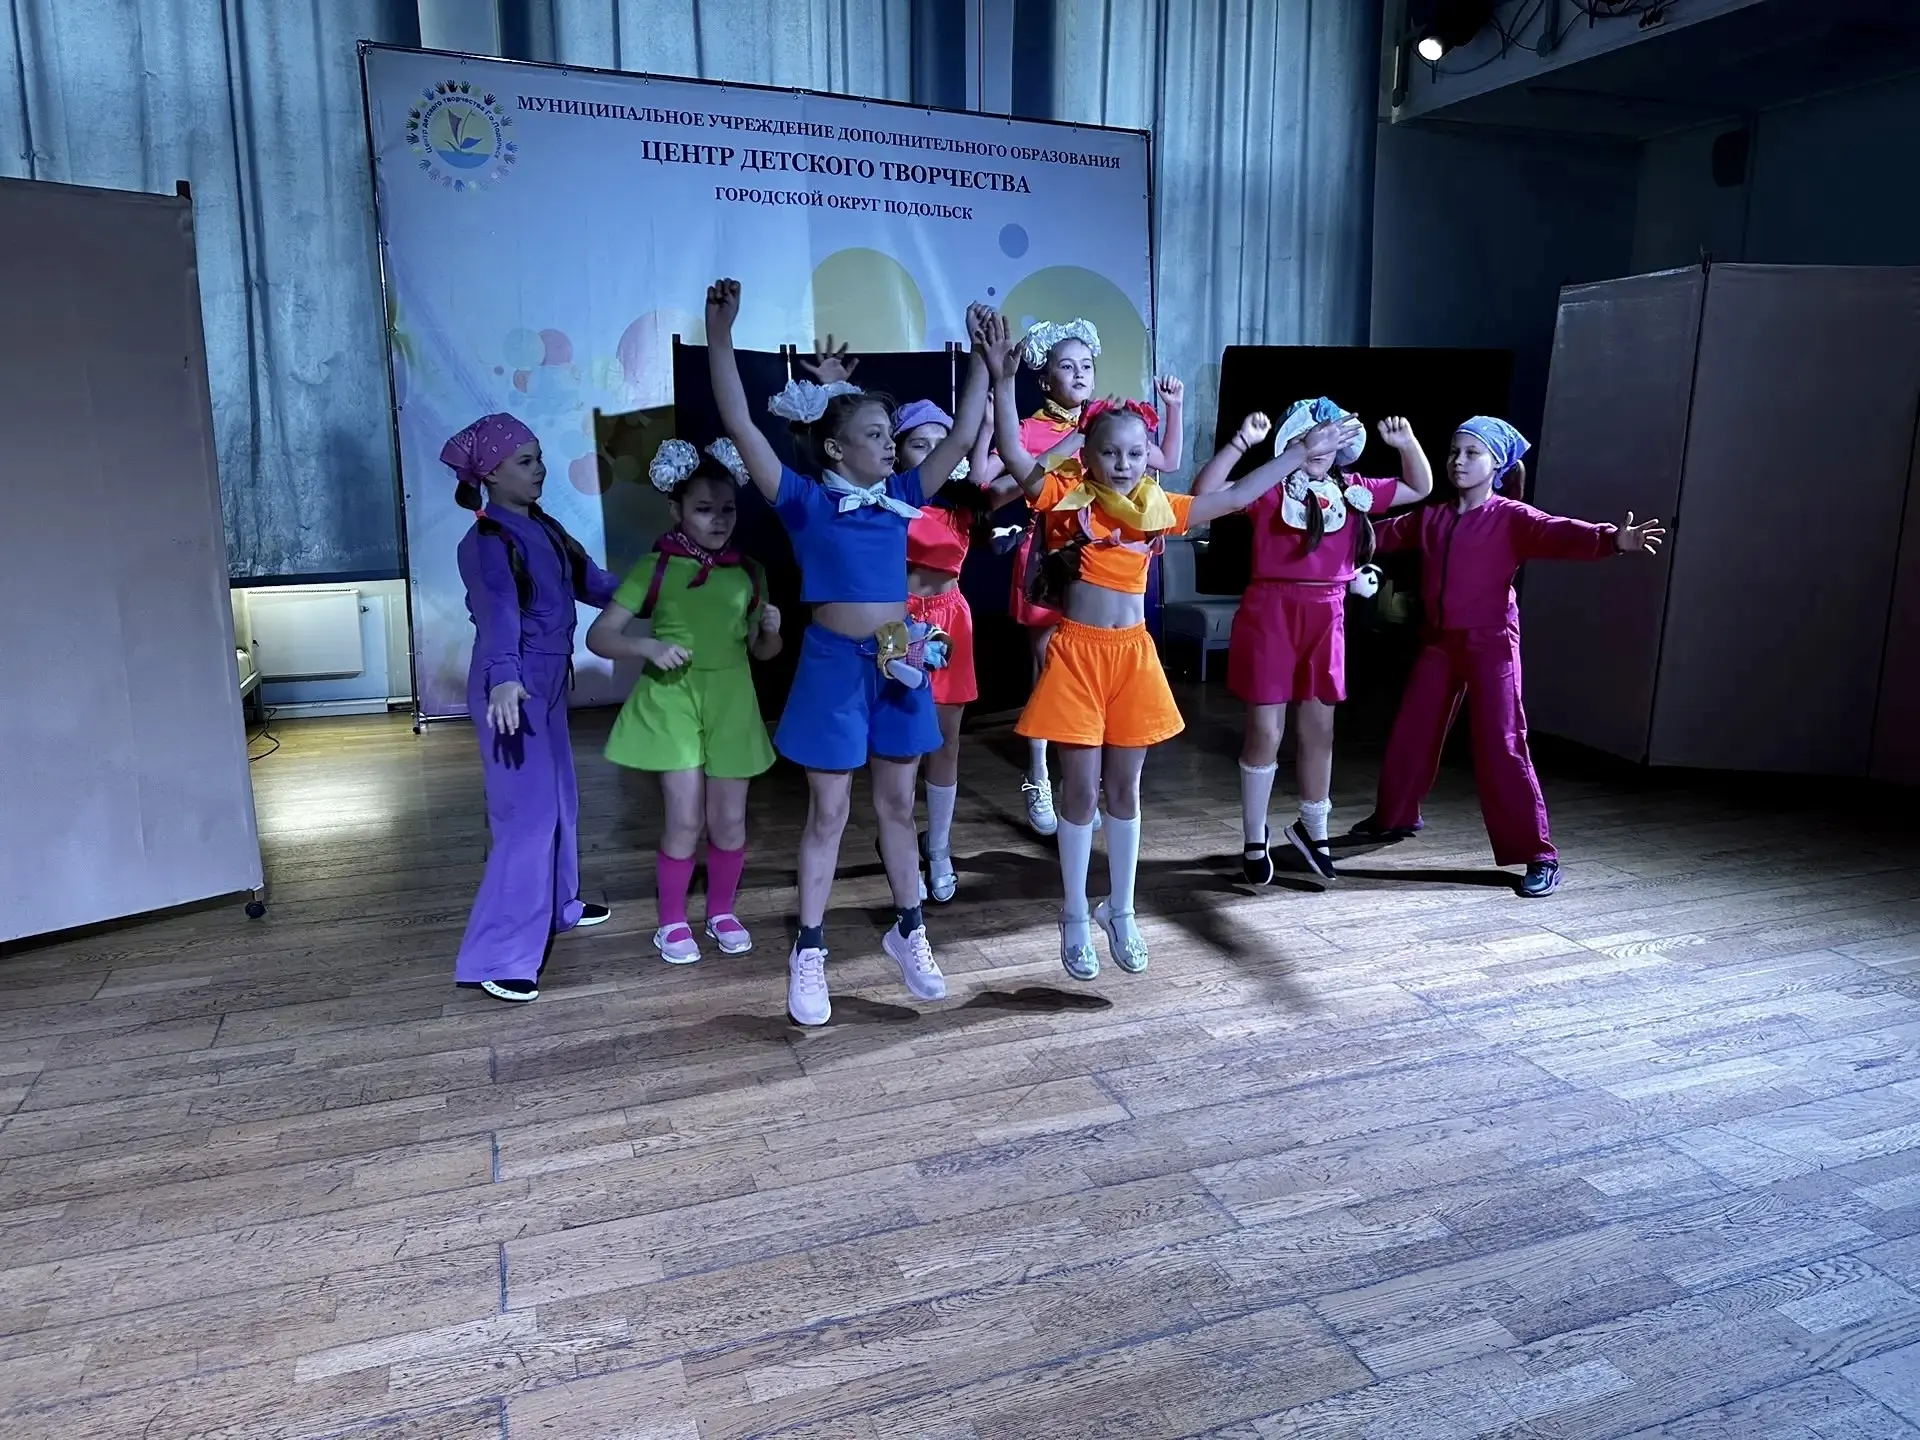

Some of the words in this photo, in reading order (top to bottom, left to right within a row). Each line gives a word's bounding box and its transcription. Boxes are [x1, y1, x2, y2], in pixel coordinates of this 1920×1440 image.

[516, 95, 705, 127] МУНИЦИПАЛЬНОЕ
[708, 114, 835, 140] УЧРЕЖДЕНИЕ
[837, 126, 1007, 158] ДОПОЛНИТЕЛЬНОГО
[1010, 146, 1121, 169] ОБРАЗОВАНИЯ
[641, 140, 735, 166] ЦЕНТР
[740, 148, 875, 179] ДЕТСКОГО
[879, 161, 1032, 194] ТВОРЧЕСТВА
[714, 186, 824, 207] ГОРОДСКОЙ
[827, 194, 881, 212] ОКРУГ
[884, 200, 974, 221] ПОДОЛЬСК
